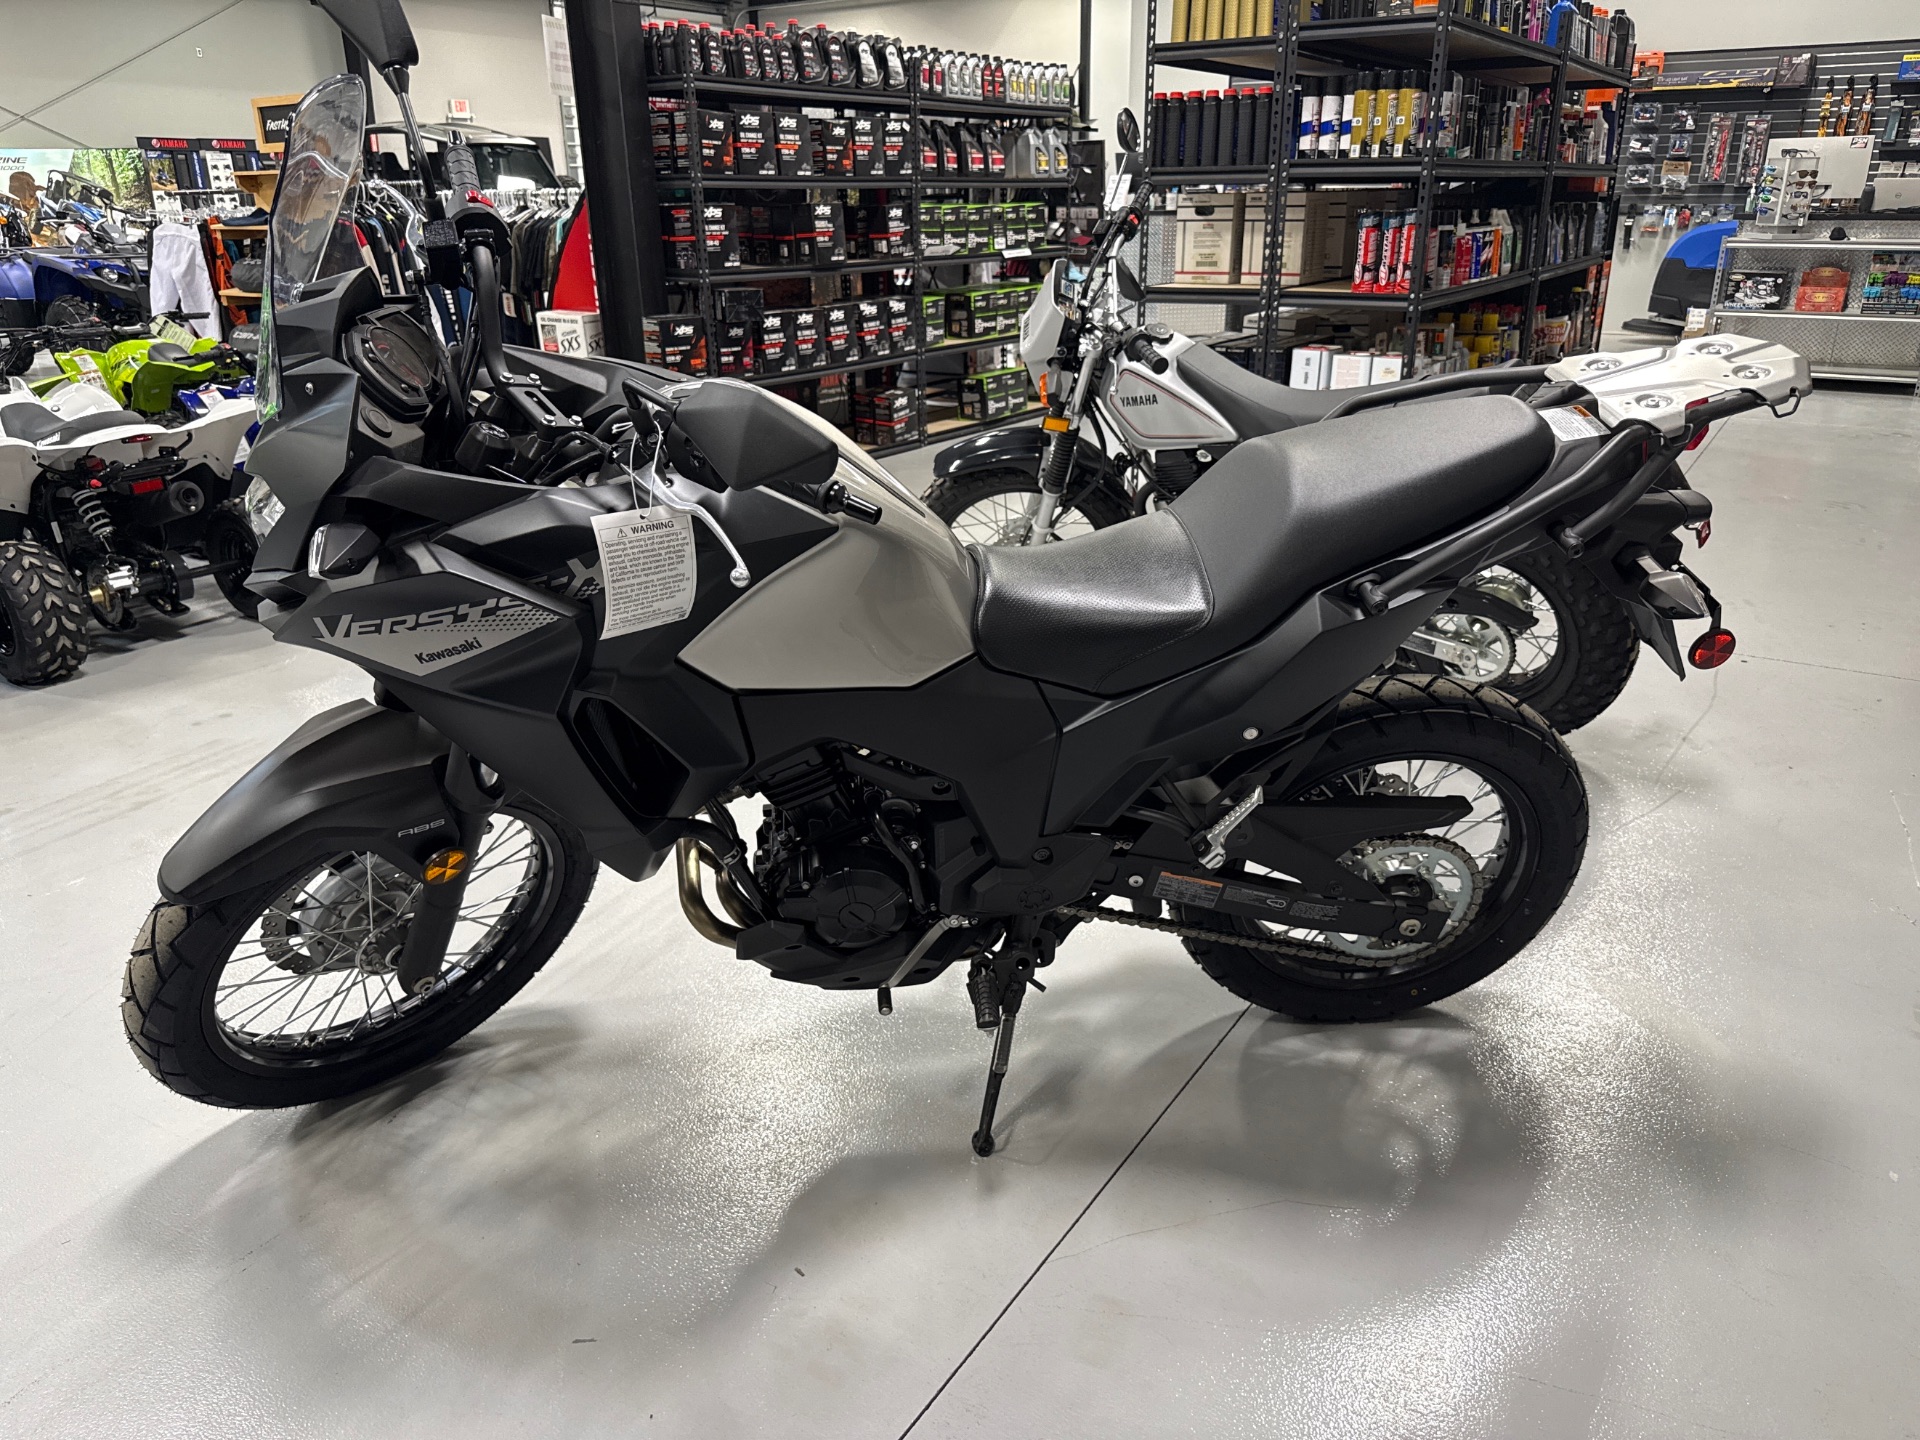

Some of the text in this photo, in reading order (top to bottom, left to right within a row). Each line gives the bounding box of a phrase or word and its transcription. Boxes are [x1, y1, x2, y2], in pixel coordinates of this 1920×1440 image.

[709, 119, 724, 129] XPS
[740, 114, 760, 126] XPS
[779, 117, 797, 128] XPS
[855, 120, 871, 130] XPS
[832, 126, 845, 136] XPS
[886, 121, 901, 131] XPS
[160, 139, 188, 148] YAMAHA
[704, 206, 722, 217] XPS
[814, 205, 831, 215] XPS
[888, 208, 903, 218] XPS
[797, 313, 813, 324] XPS
[829, 310, 845, 321] XPS
[763, 316, 781, 328] XPS
[674, 324, 695, 336] XPS
[728, 327, 744, 336] XPS
[561, 335, 580, 354] SXS
[1120, 394, 1158, 407] YAMAHA
[36, 432, 61, 448] Kawasaki
[631, 520, 674, 534] WARNING
[656, 531, 678, 539] maintaining
[606, 547, 628, 555] passenger
[643, 569, 667, 578] reproductive
[312, 596, 537, 639] VERSYS
[414, 636, 482, 664] Kawasaki
[397, 818, 446, 838] ABS
